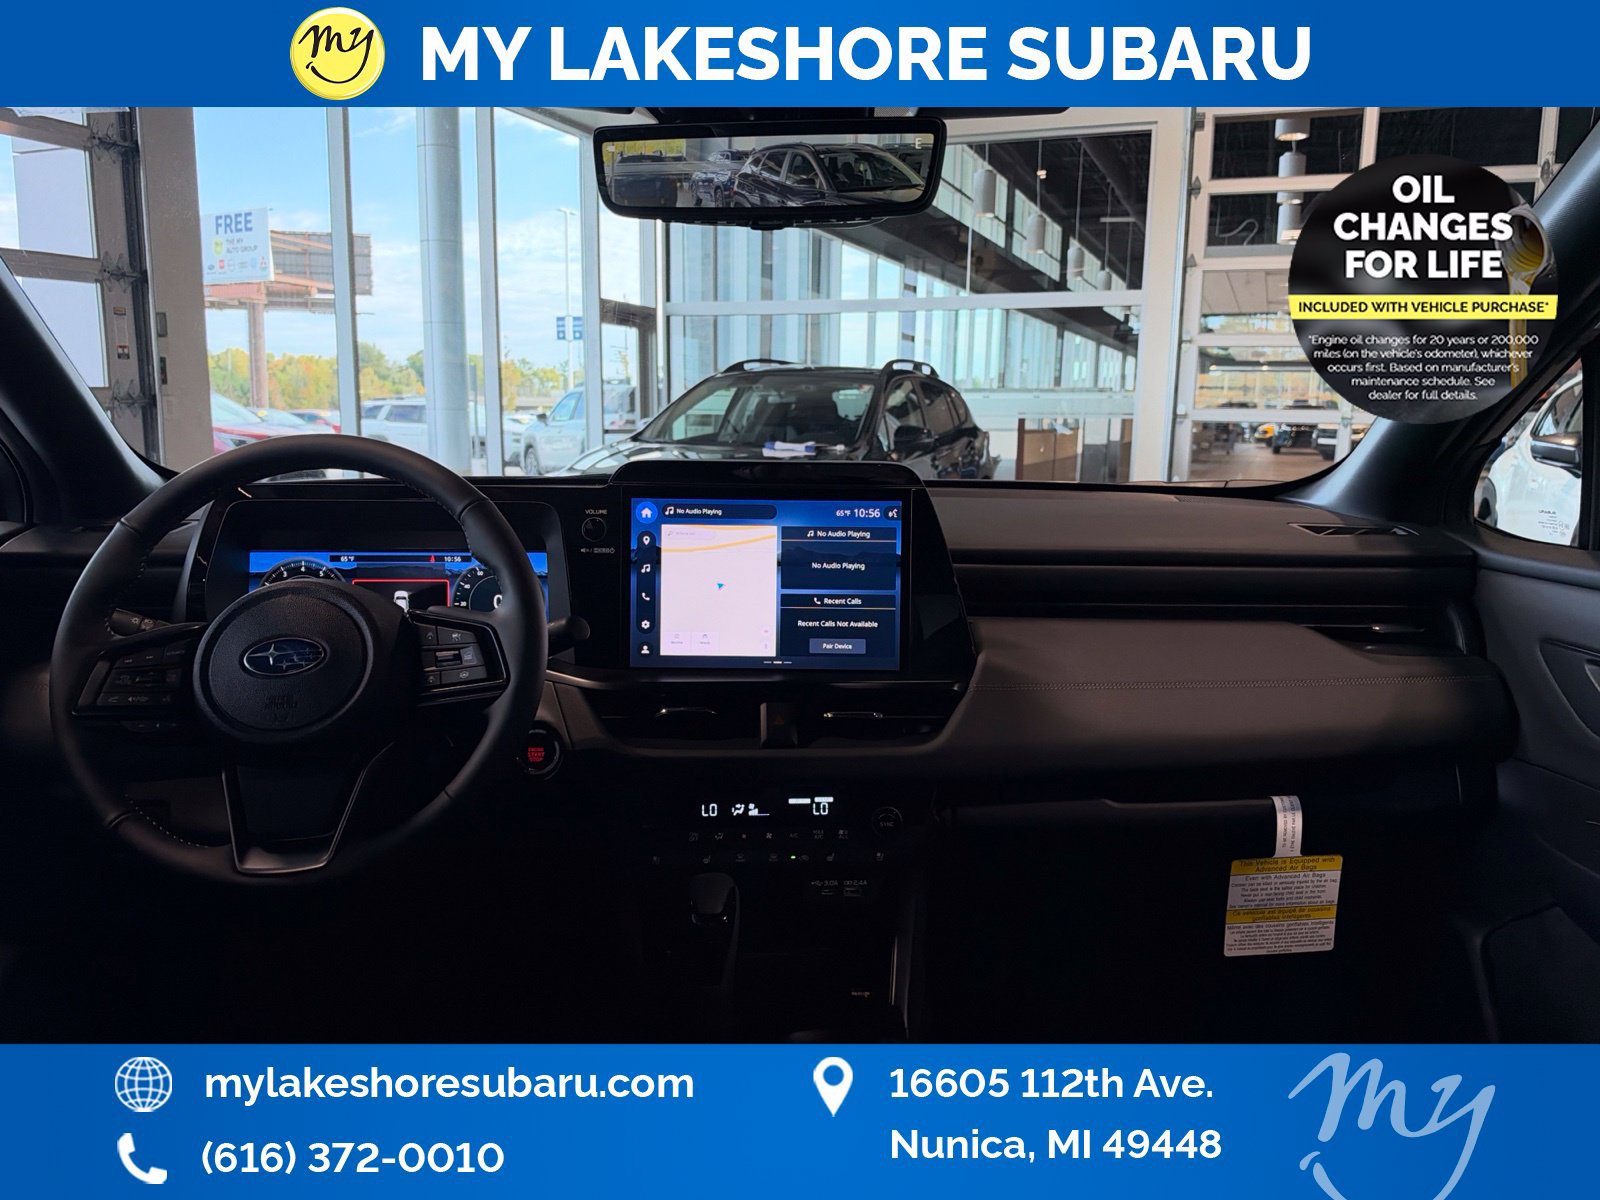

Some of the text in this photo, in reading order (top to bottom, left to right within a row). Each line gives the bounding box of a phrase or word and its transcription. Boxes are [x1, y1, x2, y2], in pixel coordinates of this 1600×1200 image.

[915, 138, 922, 149] E
[215, 212, 253, 235] FREE
[703, 508, 722, 516] Playing
[854, 508, 881, 518] 10:56
[817, 530, 871, 539] No Audio Playing
[842, 562, 865, 571] Playing
[701, 803, 718, 817] LO
[812, 803, 829, 815] LO
